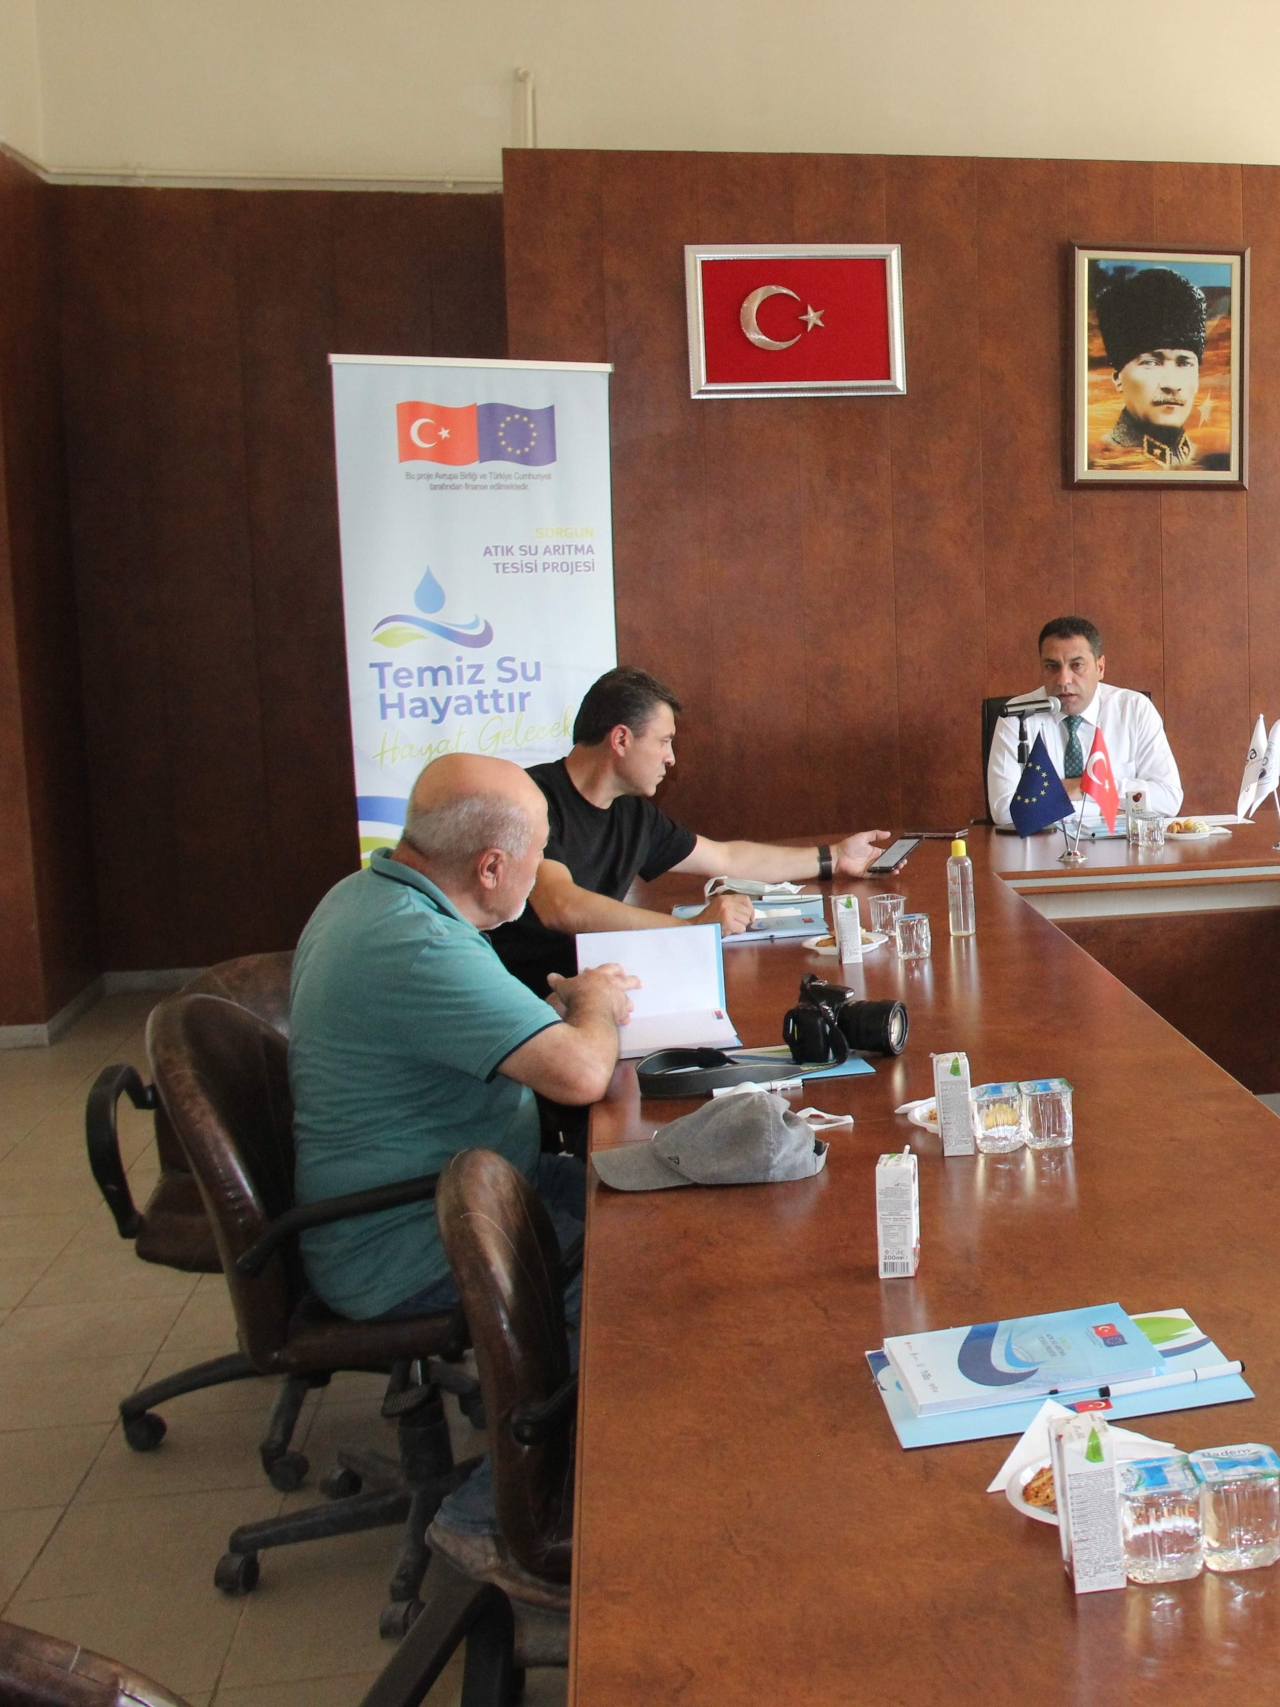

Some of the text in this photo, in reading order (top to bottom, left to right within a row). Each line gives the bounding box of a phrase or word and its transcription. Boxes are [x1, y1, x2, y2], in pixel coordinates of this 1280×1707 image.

[405, 472, 415, 480] Bu
[417, 472, 433, 482] proje
[435, 472, 458, 481] Avrupa
[489, 472, 512, 482] Türkiye
[514, 472, 552, 482] Cumhuriyeti
[429, 482, 462, 491] tarafından
[465, 482, 488, 491] finanse
[535, 526, 594, 539] SORGUN
[483, 544, 595, 557] ATIK SU ARITMA
[493, 558, 595, 575] TESİSİ PROJESİ
[369, 656, 542, 690] Temiz Su
[379, 688, 532, 725] Hayattır
[372, 704, 575, 771] Hayat Gelecek
